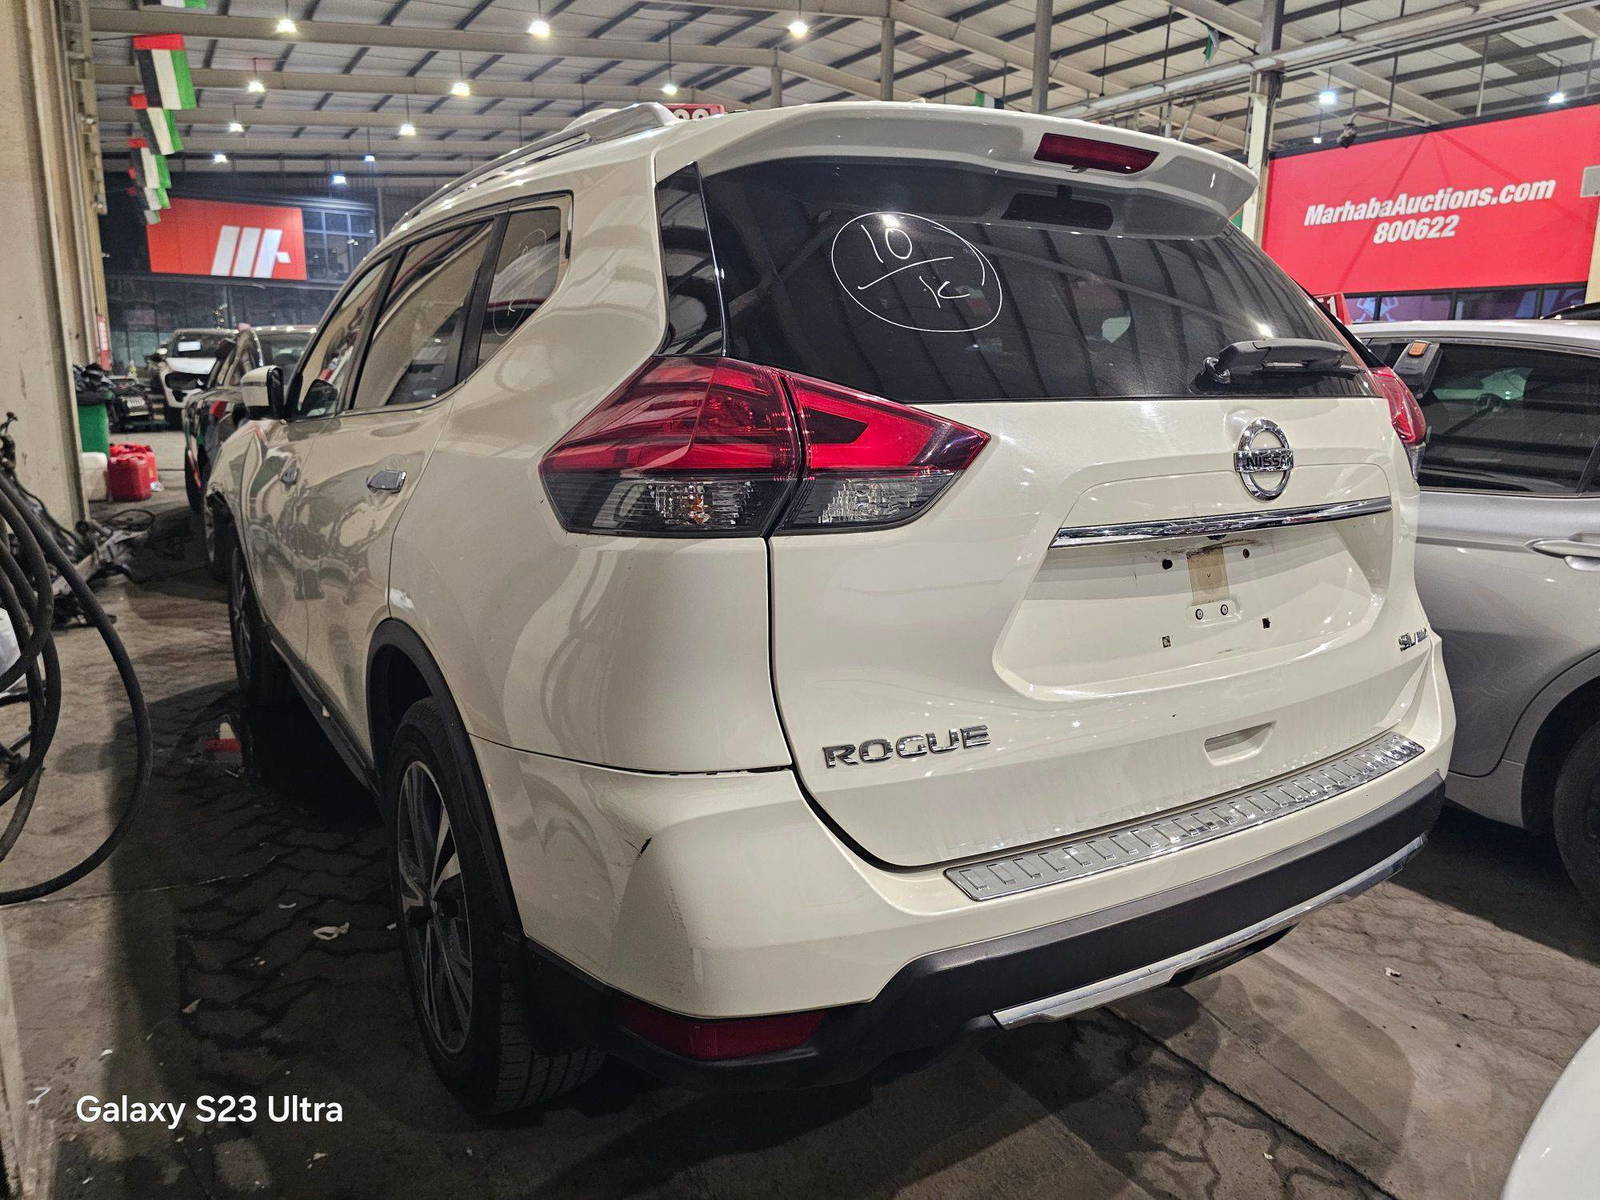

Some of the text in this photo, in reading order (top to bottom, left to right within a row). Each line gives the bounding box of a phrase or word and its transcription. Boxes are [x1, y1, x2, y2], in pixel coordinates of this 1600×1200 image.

[1303, 179, 1557, 227] MarhabaAuctions.com
[860, 223, 913, 264] 10
[1372, 214, 1460, 245] 800622
[822, 724, 992, 769] ROGUE
